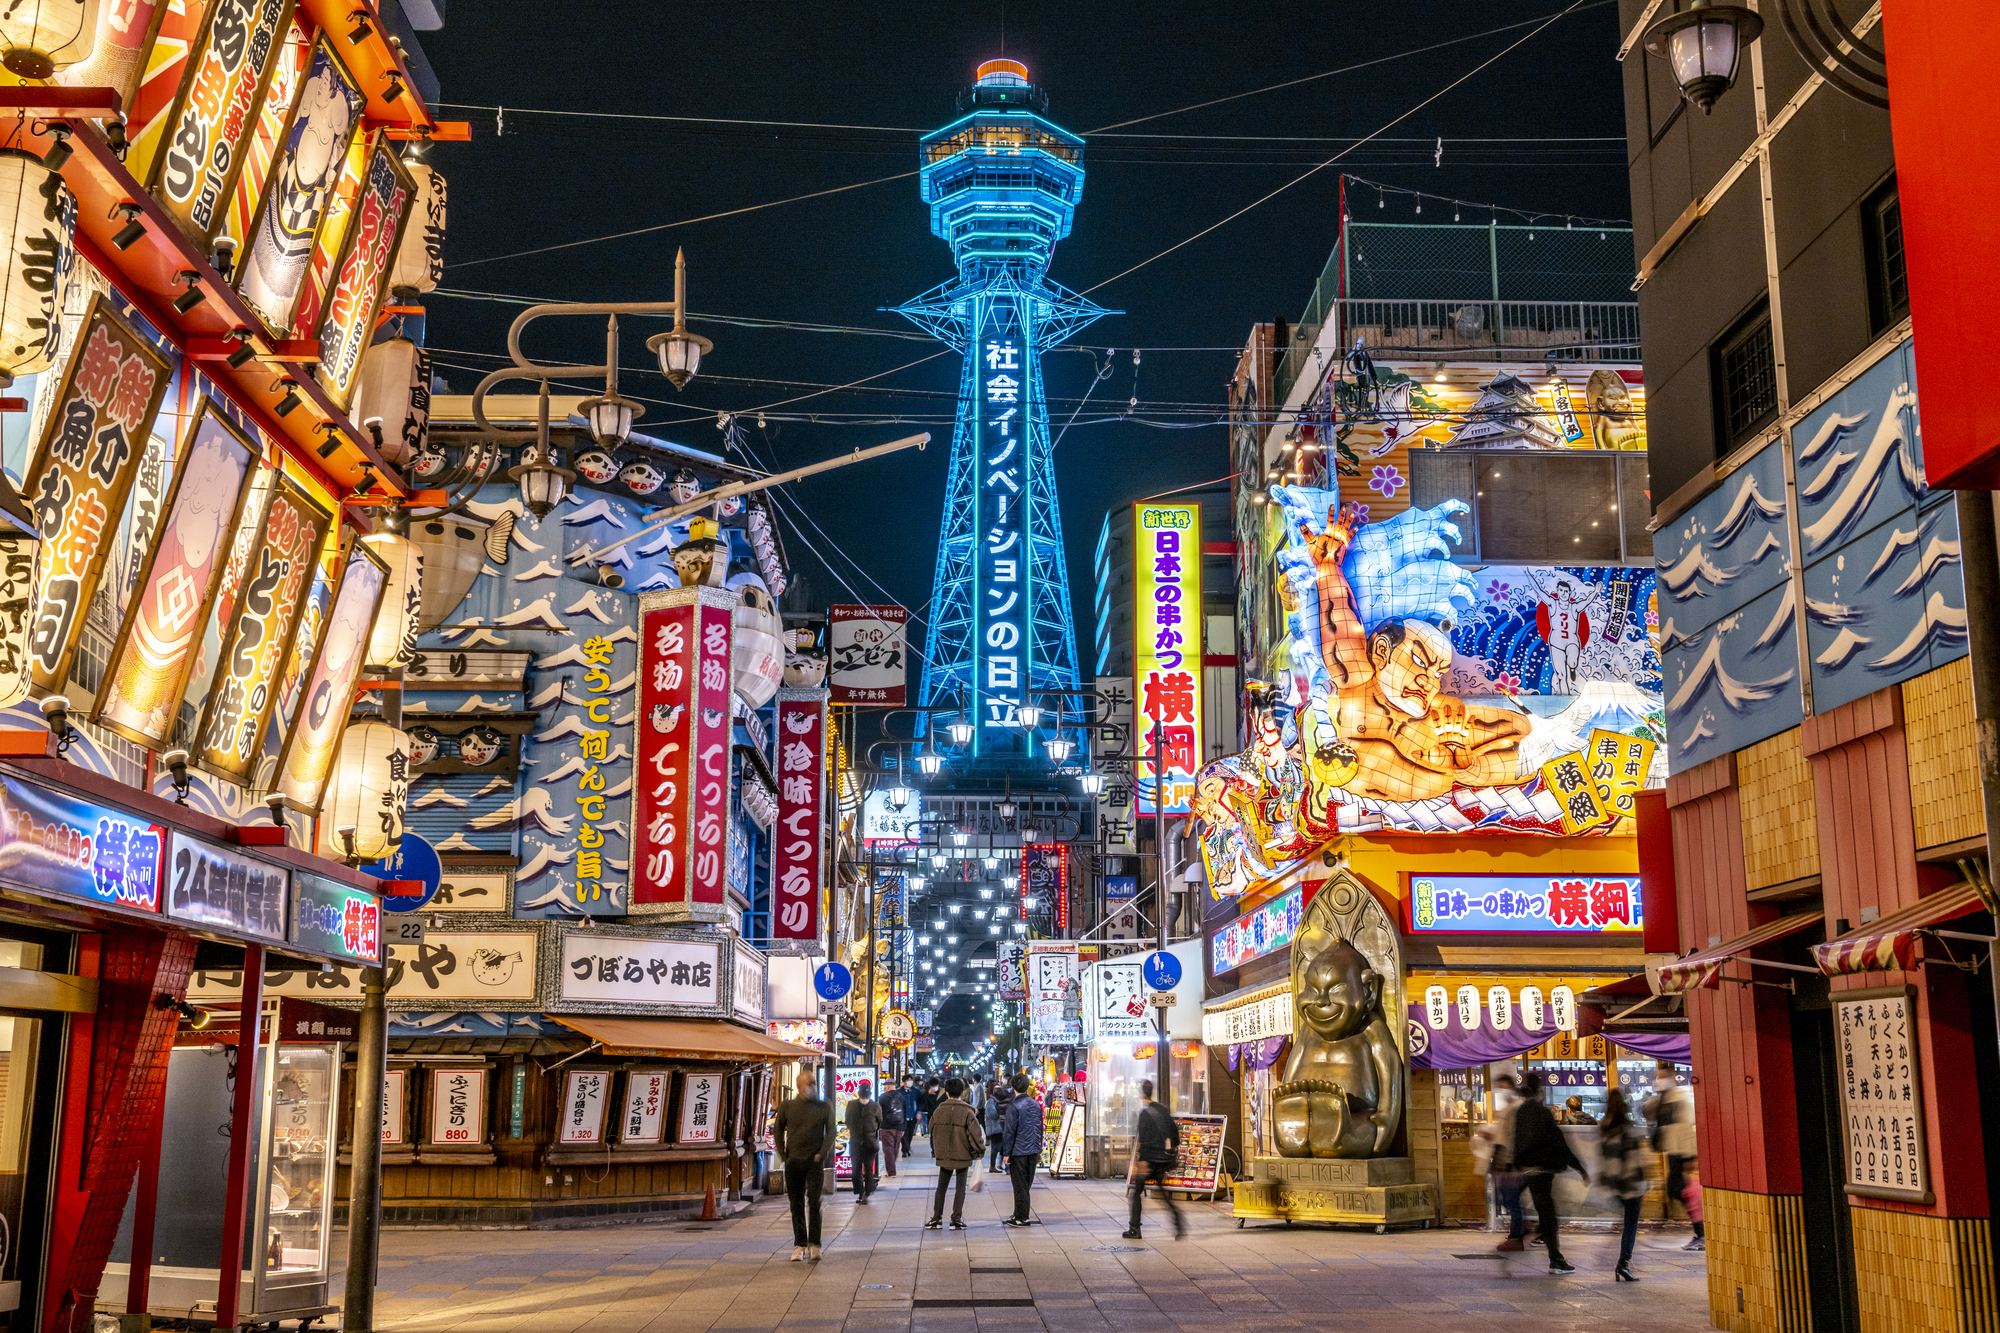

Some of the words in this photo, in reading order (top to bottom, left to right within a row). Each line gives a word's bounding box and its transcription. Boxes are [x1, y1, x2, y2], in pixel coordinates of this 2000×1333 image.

[985, 340, 1020, 729] 社会イノベーションの日立
[1144, 510, 1190, 530] 新世界
[1154, 531, 1184, 670] 日本一の串かつ
[1606, 582, 1630, 639] 開運招福
[653, 622, 685, 692] 名物
[703, 622, 728, 692] 名物
[848, 689, 888, 700] 年中無休
[1143, 672, 1197, 776] 横綱
[576, 635, 615, 904] 安うて何んでも旨い
[92, 816, 162, 907] 横綱
[1418, 882, 1433, 926] 新世界
[1435, 891, 1546, 918] 日本一の串かつ
[1548, 881, 1630, 926] 横綱
[343, 896, 380, 959] 横綱
[570, 954, 713, 989] づぼらや本店
[296, 1020, 325, 1036] 横綱
[1432, 997, 1444, 1025] 串かつ
[1459, 995, 1471, 1024] 豚バラ
[1495, 996, 1506, 1025] ホルモン
[1841, 1005, 1857, 1100] 天ぷら盛合せ
[1868, 1004, 1883, 1100] えび天ぷら
[1881, 1003, 1897, 1101] ふぐうどん
[1895, 1003, 1911, 1101] ふぐかつ丼
[629, 1096, 644, 1136] ふぐ料理
[646, 1077, 661, 1116] おみやげ
[692, 1078, 711, 1126] ふぐ唐揚
[445, 1129, 469, 1140] 880
[571, 1130, 592, 1139] 1,320
[689, 1129, 709, 1139] 1,540
[1267, 1162, 1354, 1182] BILLIKEN
